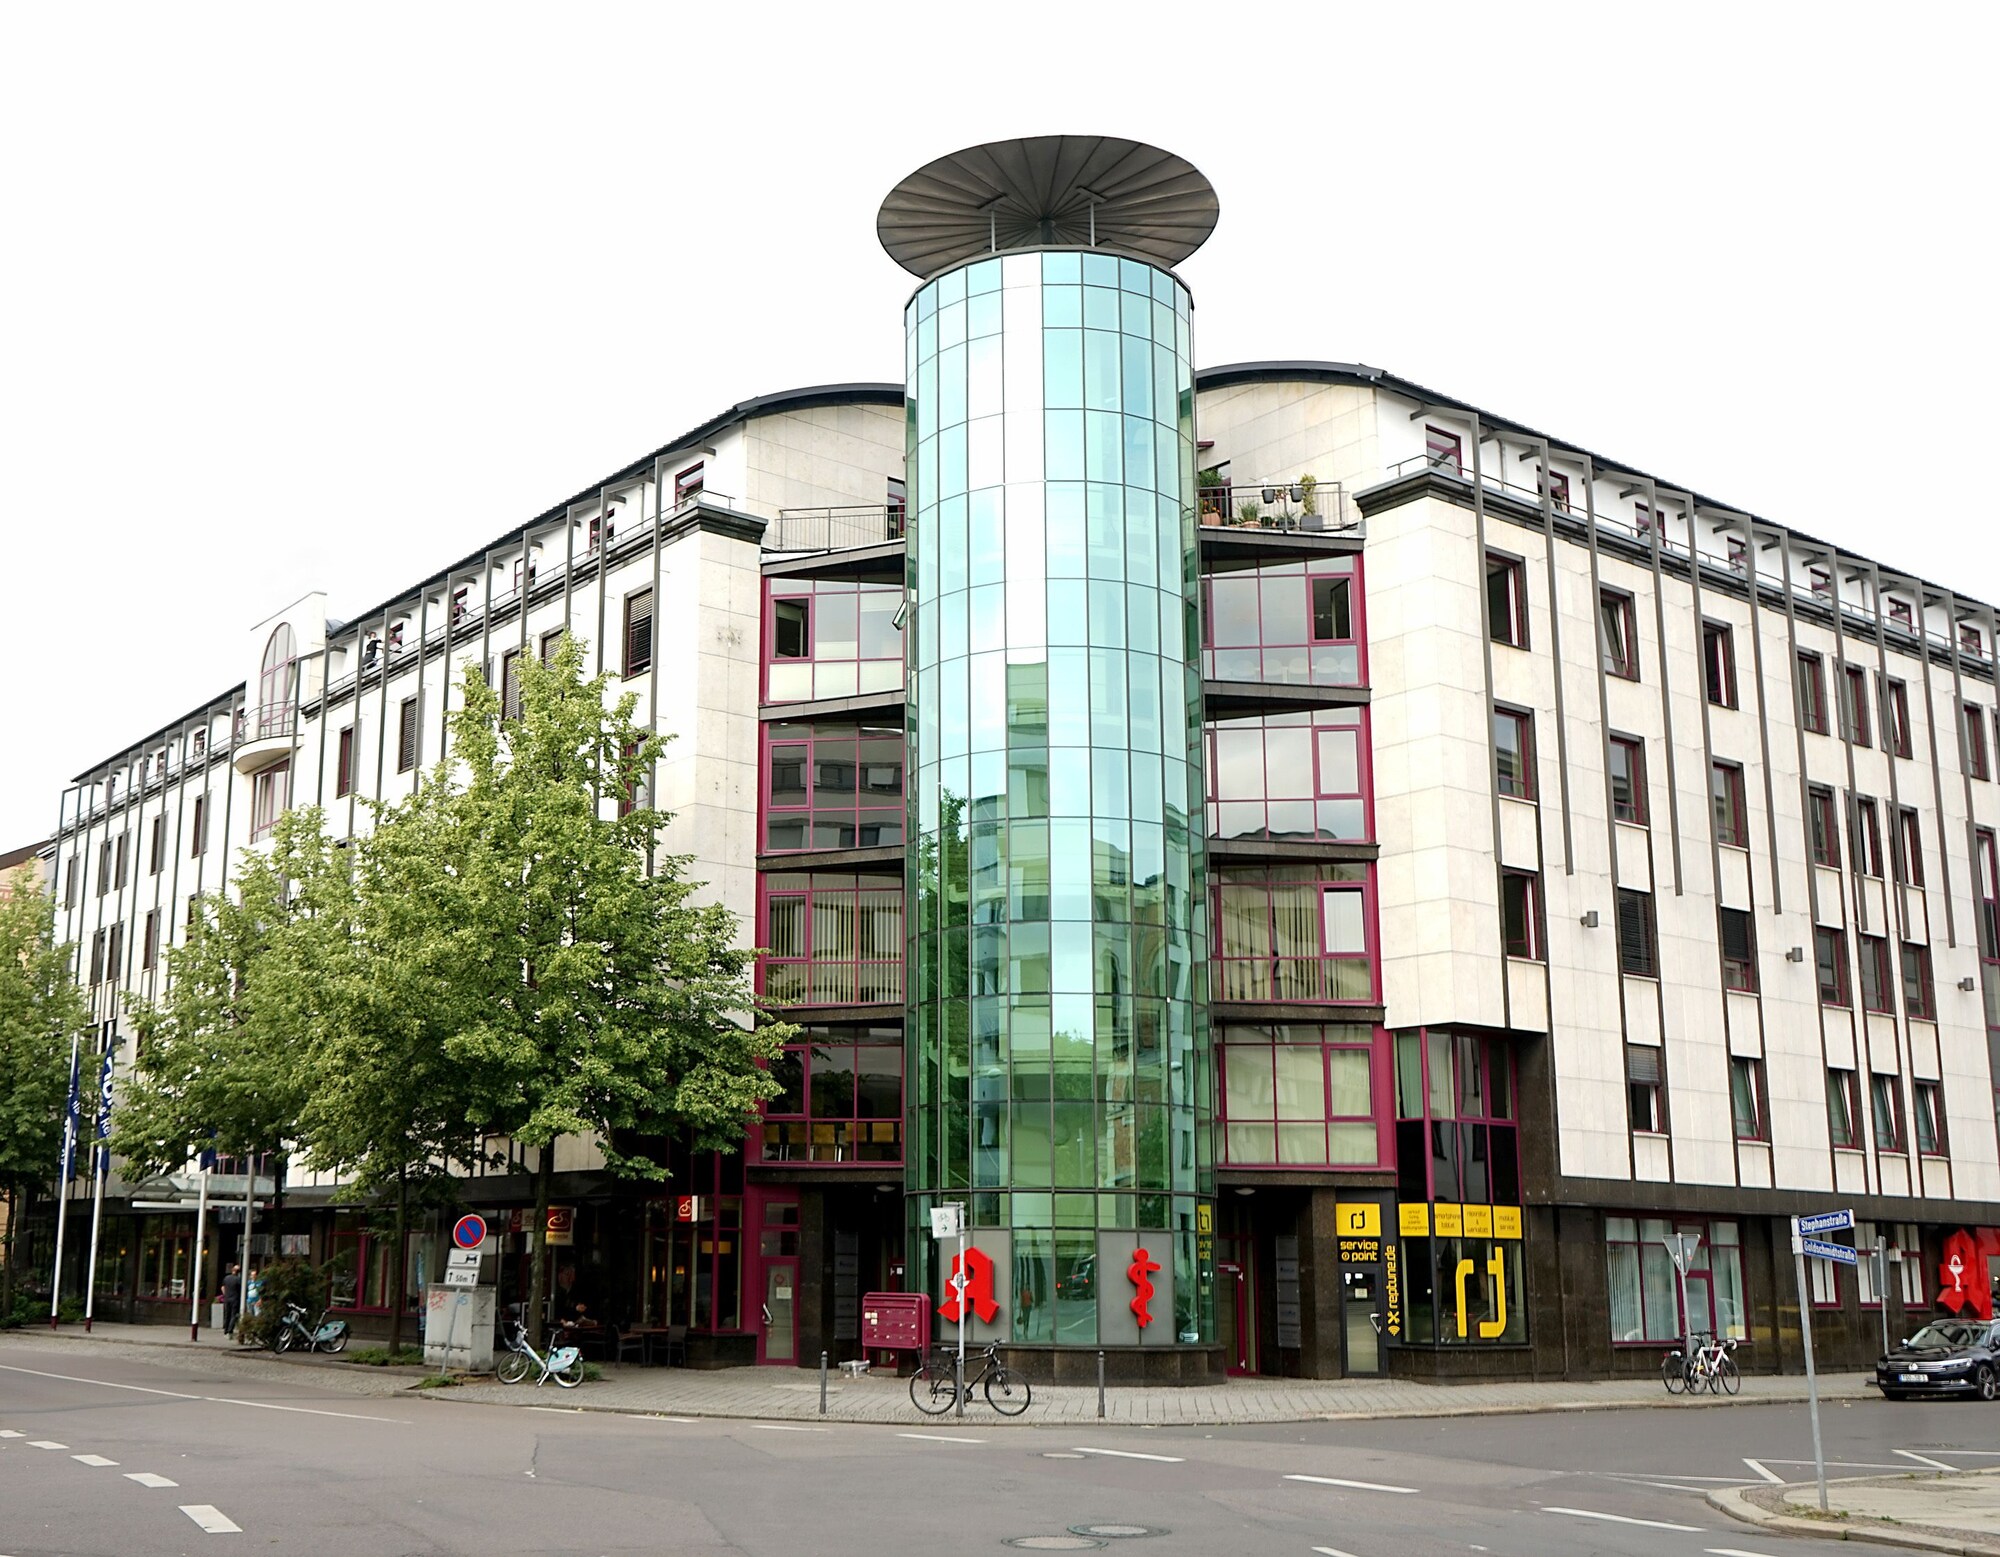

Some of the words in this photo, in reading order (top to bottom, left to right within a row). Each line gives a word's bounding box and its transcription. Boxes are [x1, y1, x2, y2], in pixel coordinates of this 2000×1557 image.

[1801, 1213, 1848, 1232] Stephanstraße
[1340, 1240, 1379, 1251] service
[1803, 1240, 1855, 1261] Goldschmidtstraße
[1351, 1251, 1378, 1262] point
[1385, 1245, 1399, 1309] reptune.de
